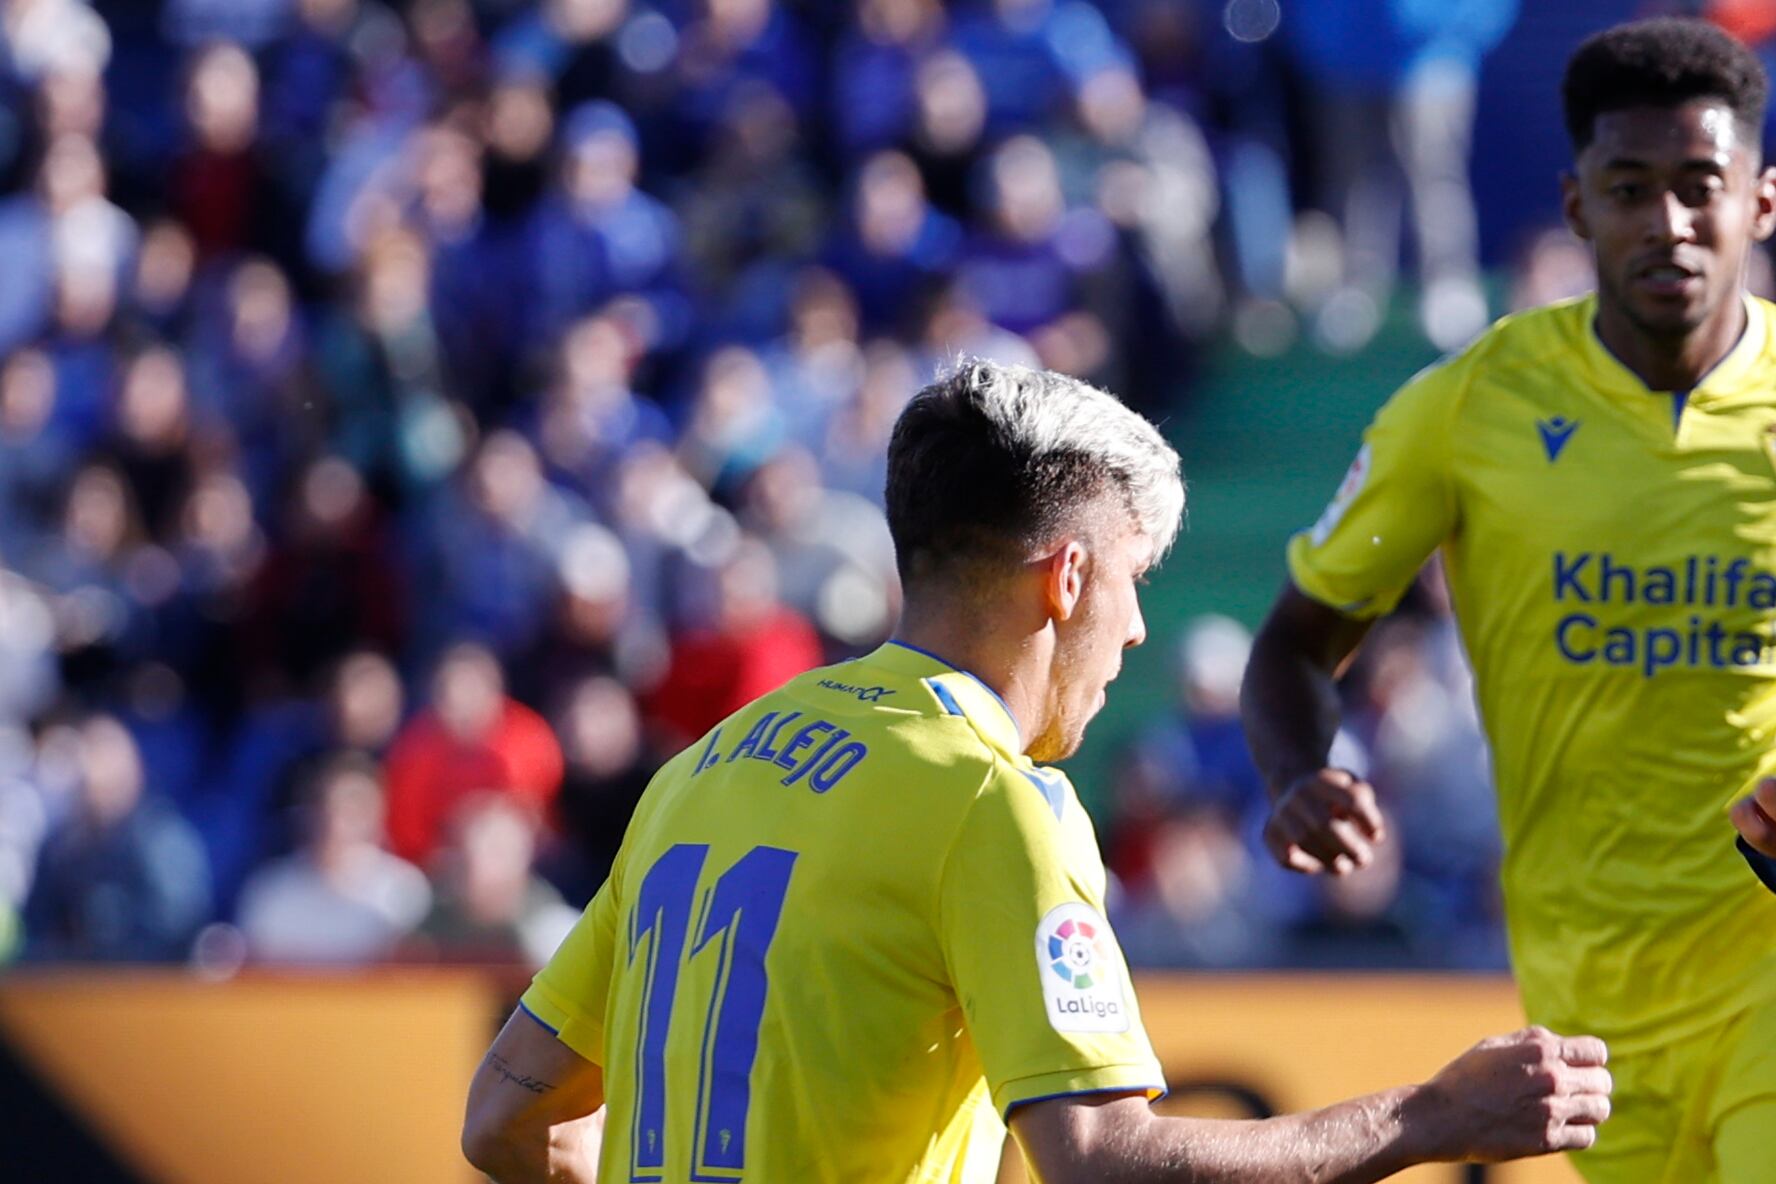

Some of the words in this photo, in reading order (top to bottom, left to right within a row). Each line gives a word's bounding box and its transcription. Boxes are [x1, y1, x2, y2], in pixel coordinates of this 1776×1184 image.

[725, 711, 868, 793] ALEJO
[627, 843, 799, 1184] 11
[1056, 995, 1119, 1018] LaLiga
